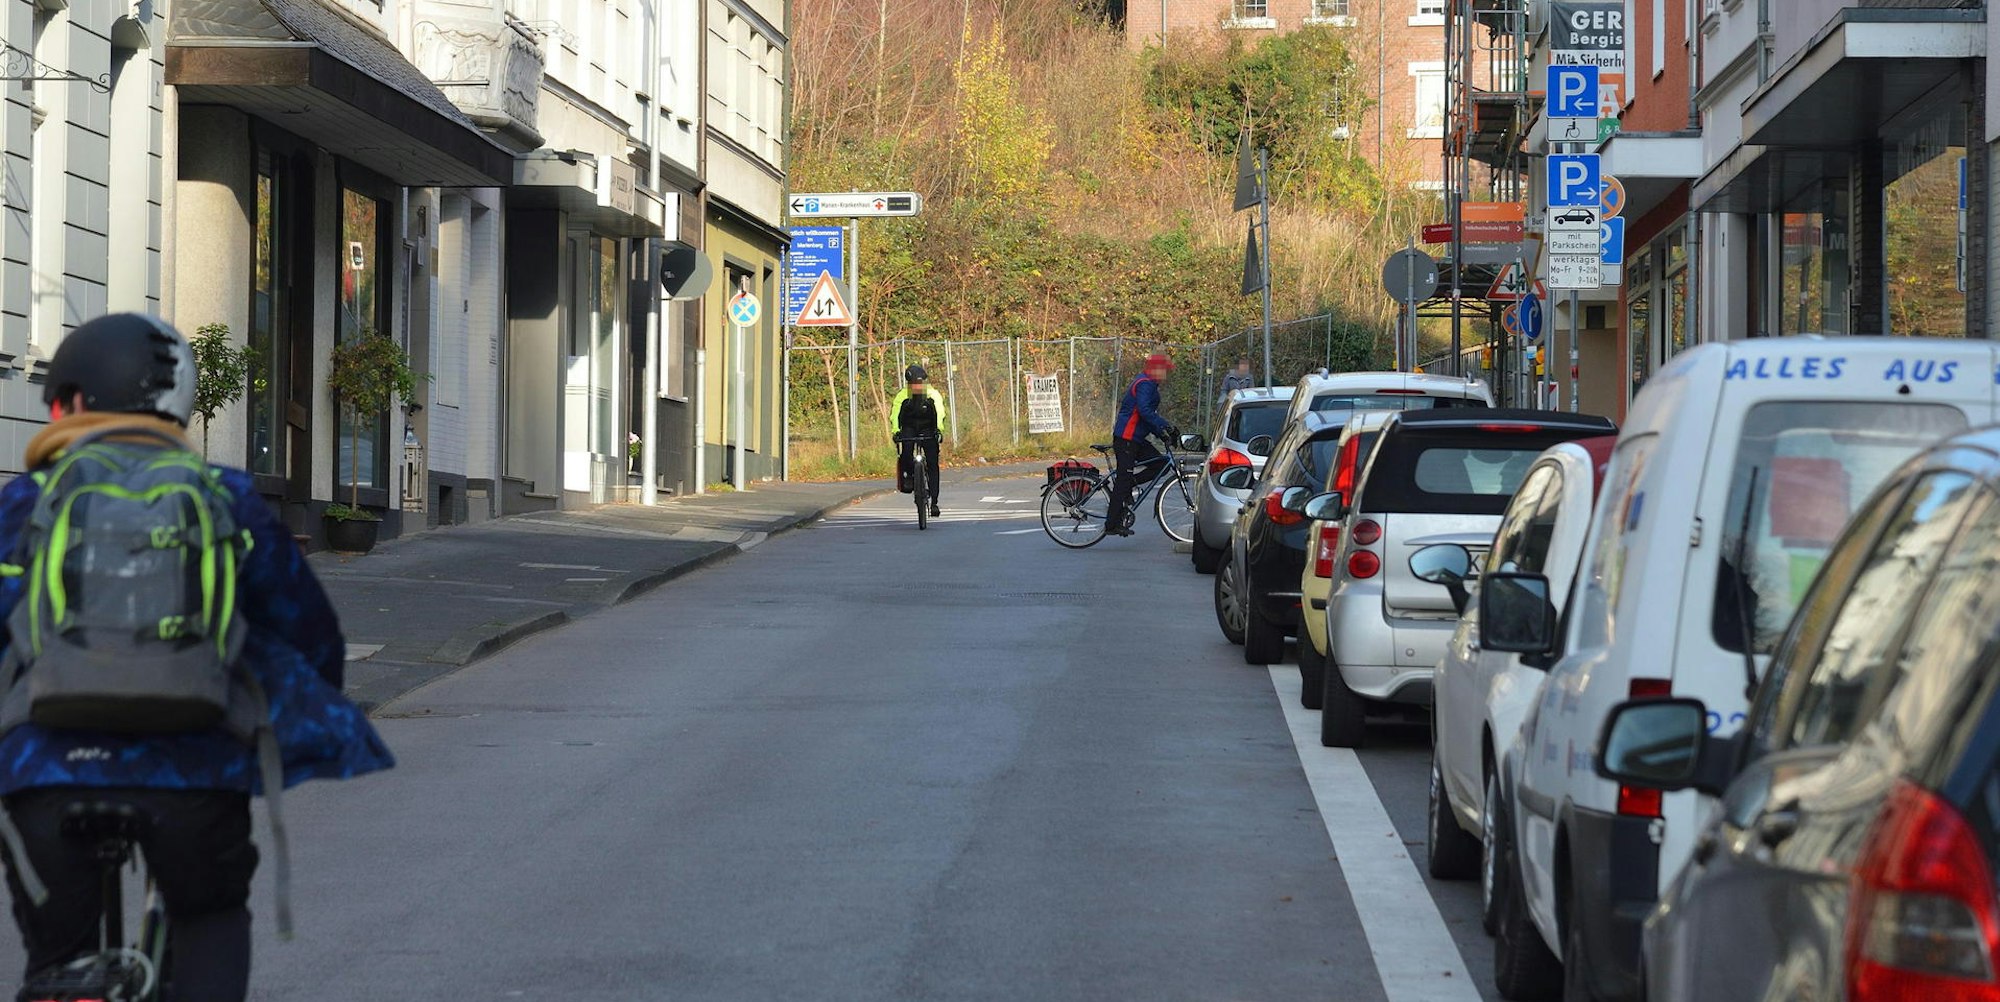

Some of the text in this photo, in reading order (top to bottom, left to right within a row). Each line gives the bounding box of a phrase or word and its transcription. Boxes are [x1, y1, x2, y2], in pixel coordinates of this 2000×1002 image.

[1571, 10, 1623, 30] GER
[1570, 32, 1623, 48] Bergis
[1580, 53, 1625, 67] Sicherh
[1559, 72, 1587, 111] P
[1560, 161, 1588, 200] P
[1552, 241, 1597, 249] Parkschein
[1553, 256, 1596, 265] werktags
[1550, 266, 1572, 274] Mo-Fr
[1550, 276, 1559, 284] Sa
[1725, 356, 1959, 382] ALLES AUS
